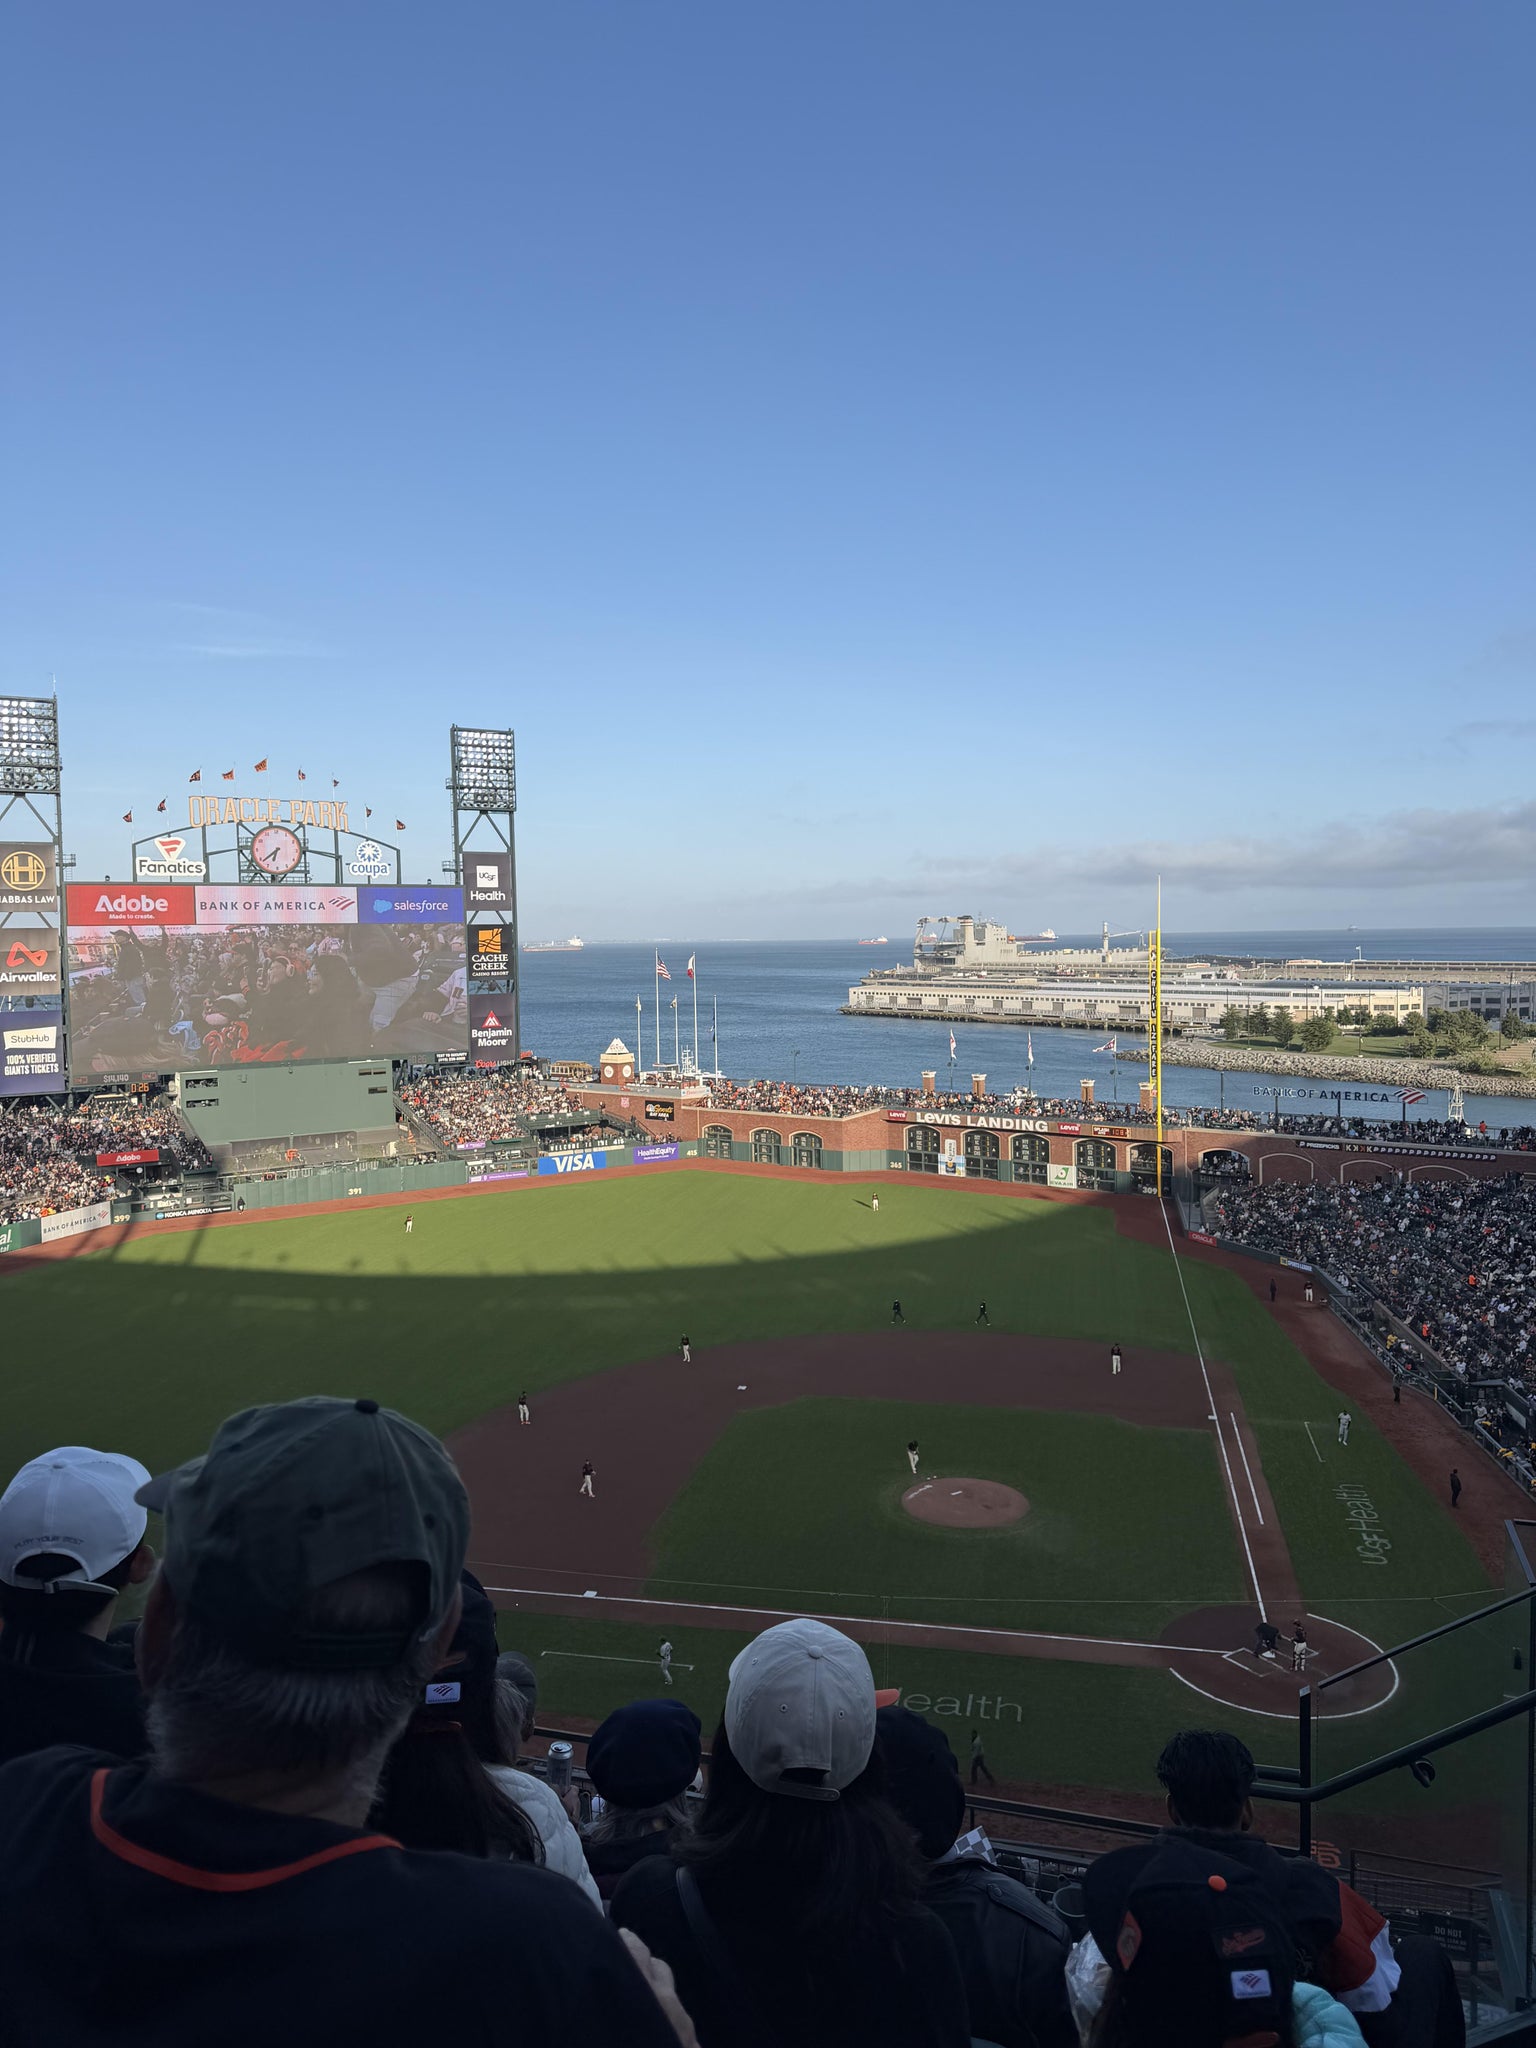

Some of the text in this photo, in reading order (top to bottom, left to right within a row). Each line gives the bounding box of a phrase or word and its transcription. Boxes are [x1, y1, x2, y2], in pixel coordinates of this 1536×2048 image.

[188, 796, 349, 833] ORACLE PARK
[138, 860, 203, 874] Fanatics
[351, 863, 388, 876] coupa
[34, 895, 55, 904] LAW
[470, 891, 506, 901] Health
[95, 895, 168, 912] Adobe
[200, 901, 326, 910] BANK OF AMERICA
[394, 900, 448, 913] salesforce
[472, 954, 508, 962] CACHE
[472, 962, 508, 970] CREEK
[0, 972, 57, 983] Airwallex
[472, 1028, 512, 1038] Benjamin
[11, 1035, 50, 1044] StubHub
[478, 1038, 508, 1047] Moore
[6, 1053, 56, 1065] 100% VERIFIED
[475, 1059, 497, 1068] Coors
[4, 1063, 59, 1076] GIANTS TICKETS
[1253, 1086, 1390, 1102] BANK OF AMERICA
[967, 1115, 1048, 1132] LANDING
[637, 1147, 676, 1157] HealthEquity
[116, 1154, 141, 1162] Adobe
[551, 1154, 595, 1173] VISA
[890, 1161, 902, 1169] 365
[348, 1187, 362, 1195] 391
[1142, 1186, 1158, 1195] 309
[164, 1208, 212, 1218] KONICA MINOLTA
[114, 1214, 131, 1223] 399
[43, 1225, 60, 1234] BANK
[70, 1216, 97, 1227] AMERICA
[1191, 1233, 1213, 1244] ORACLE
[1331, 1484, 1392, 1565] UCSF Health
[897, 1687, 1022, 1722] ealth
